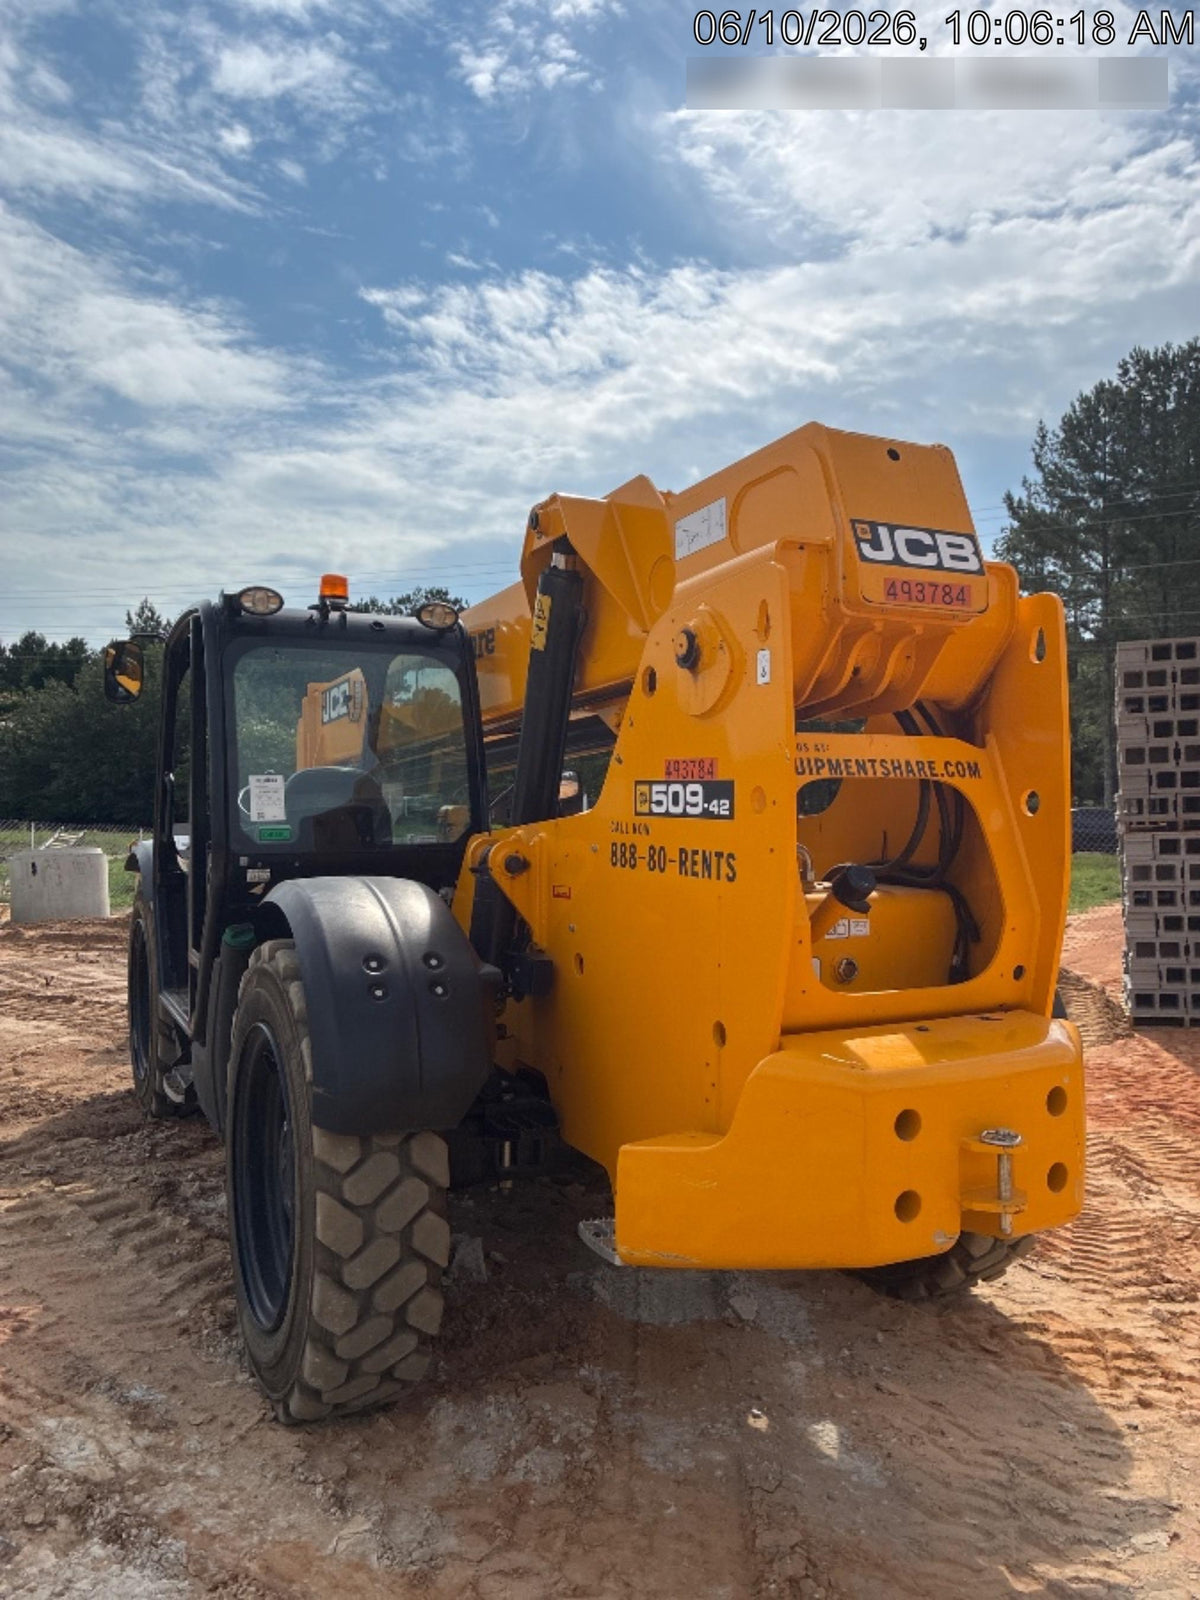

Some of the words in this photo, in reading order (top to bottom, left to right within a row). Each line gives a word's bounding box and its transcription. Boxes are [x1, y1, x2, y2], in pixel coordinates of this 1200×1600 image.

[859, 525, 981, 571] JCB
[886, 580, 967, 606] 493784
[665, 758, 716, 780] 493784
[794, 757, 982, 779] UIPMENTSHARE.COM
[610, 841, 737, 882] 888-80-RENTS
